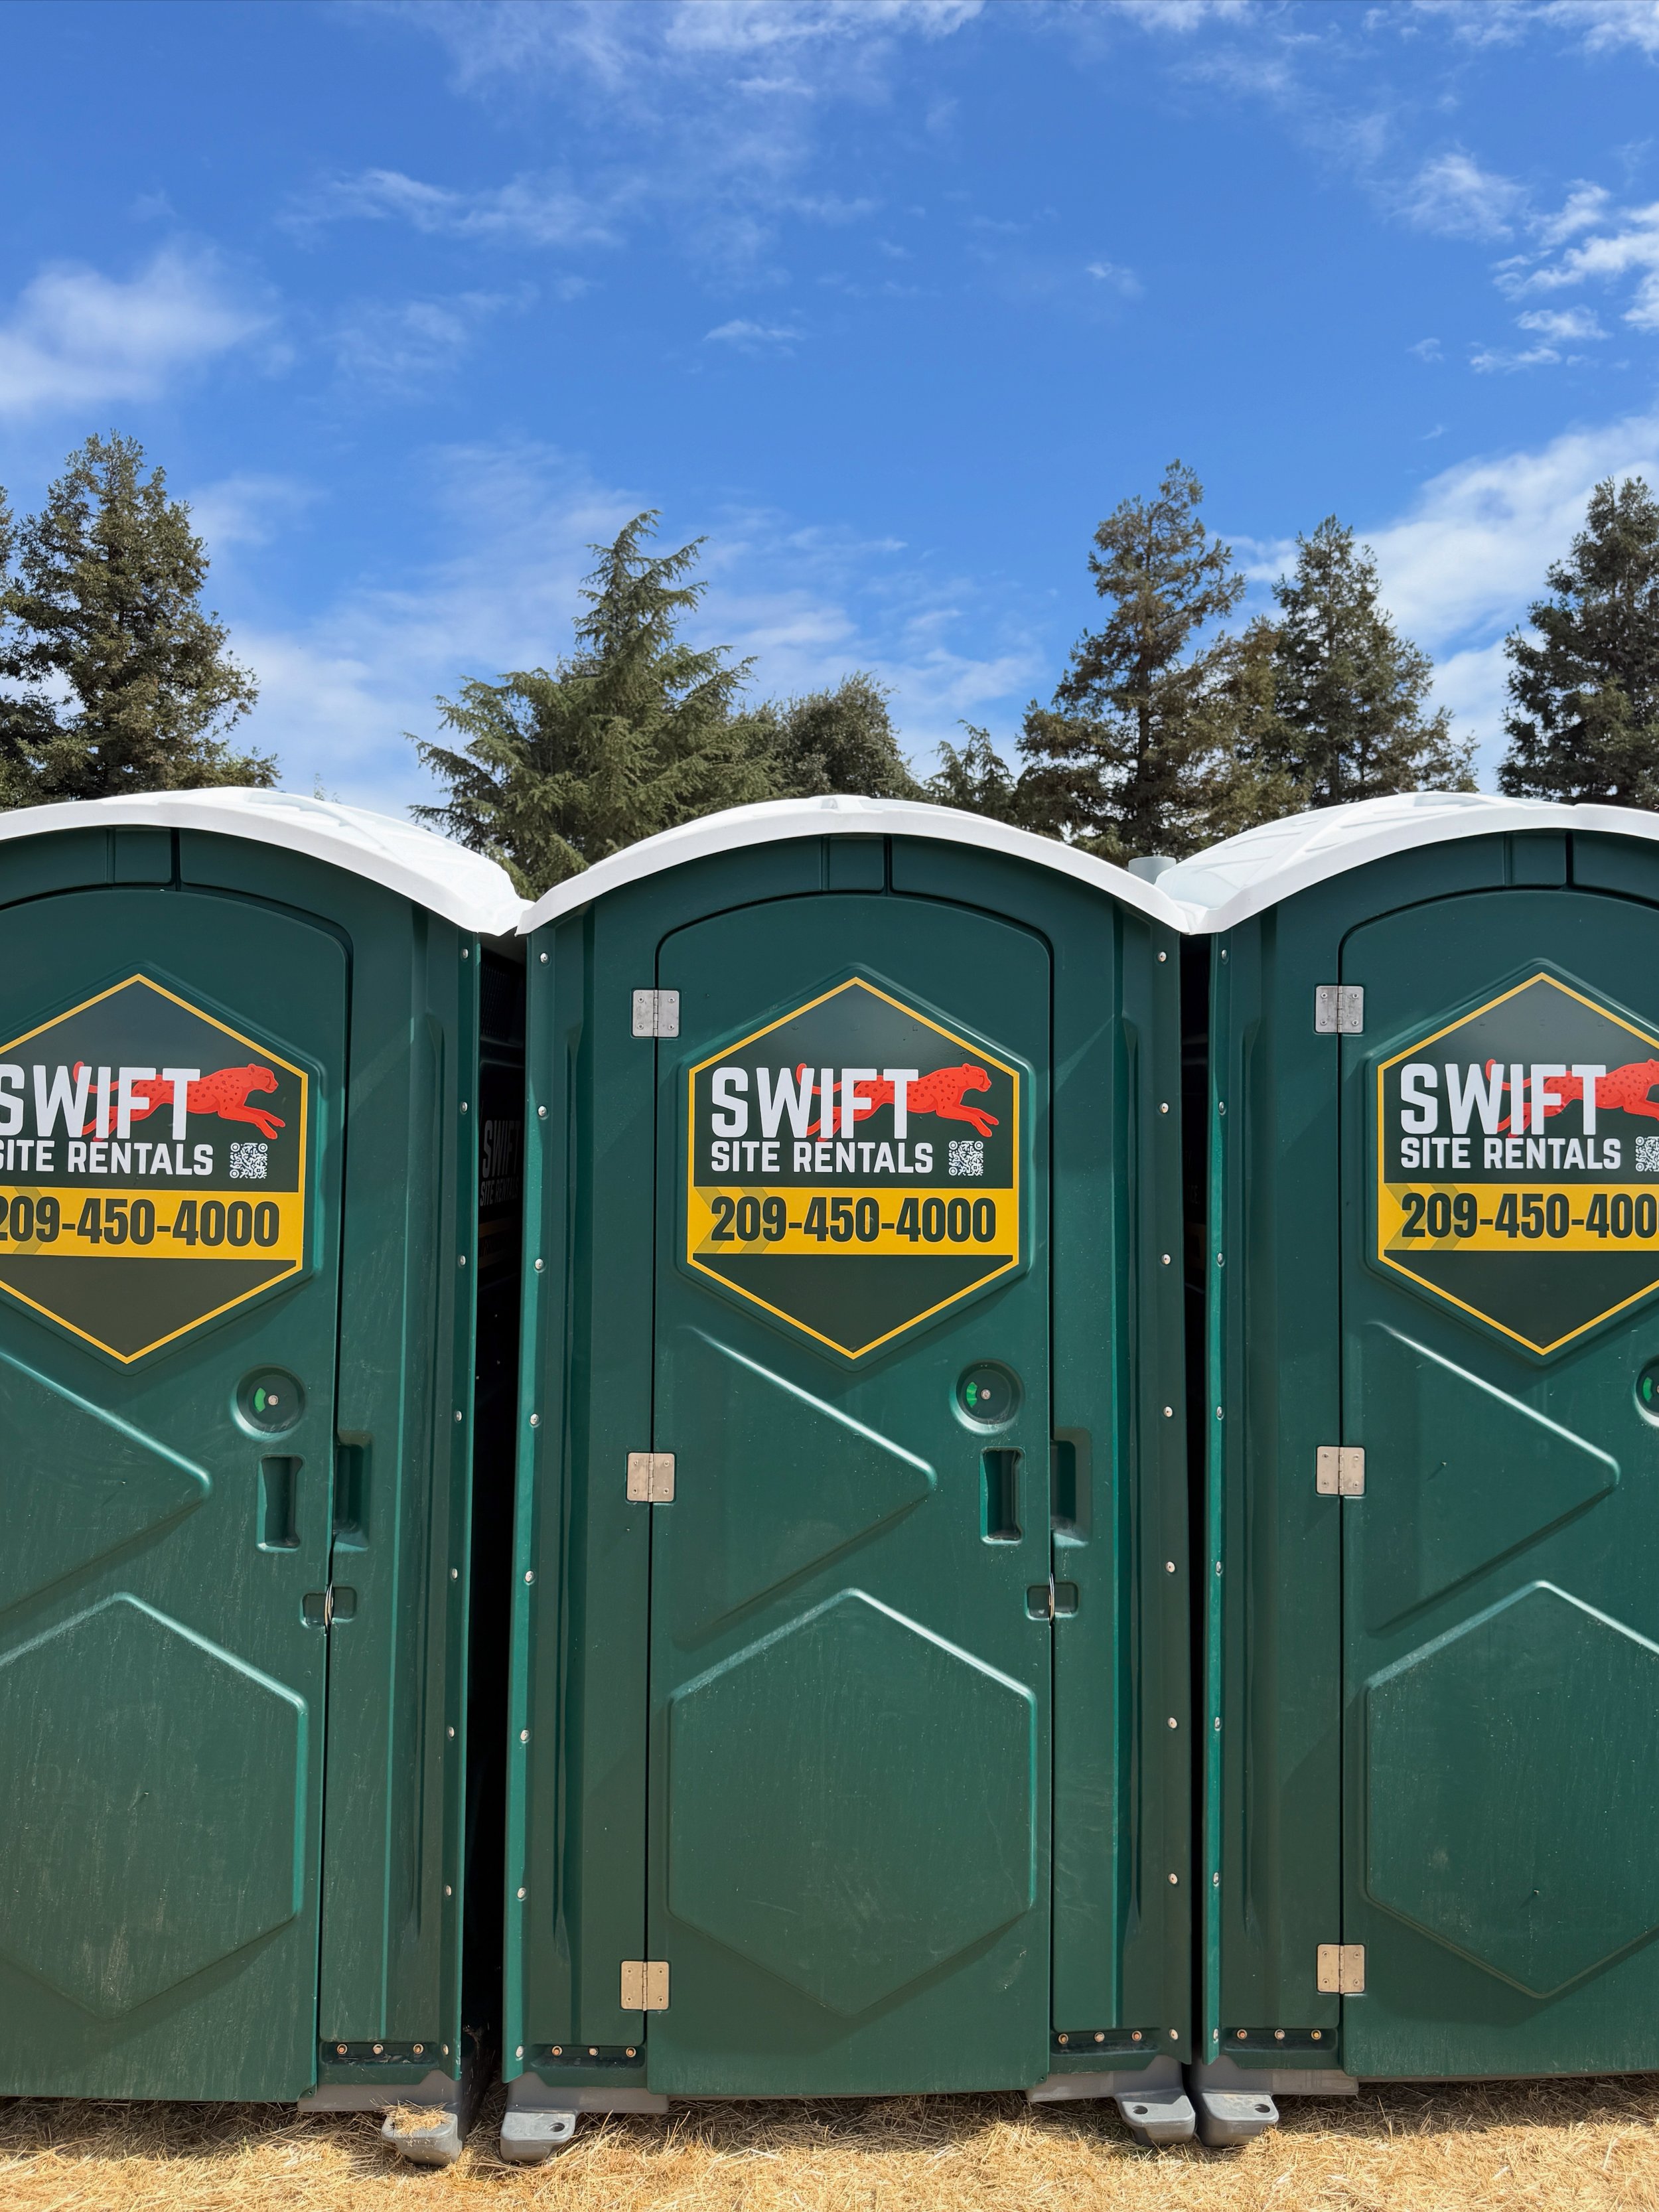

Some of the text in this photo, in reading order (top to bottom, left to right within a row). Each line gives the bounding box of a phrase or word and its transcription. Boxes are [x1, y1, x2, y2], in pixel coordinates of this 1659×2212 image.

[0, 1063, 200, 1140] SWIFT
[711, 1067, 919, 1140] SWIFT
[1400, 1063, 1607, 1136] SWIFT
[0, 1140, 214, 1176] ITE RENTALS
[483, 1120, 520, 1178] SWIFT
[711, 1141, 934, 1173] SITE RENTALS
[1400, 1137, 1621, 1170] SITE RENTALS
[480, 1181, 494, 1207] SITE
[1401, 1193, 1659, 1239] 209-450-400
[711, 1196, 997, 1243] 209-450-4000
